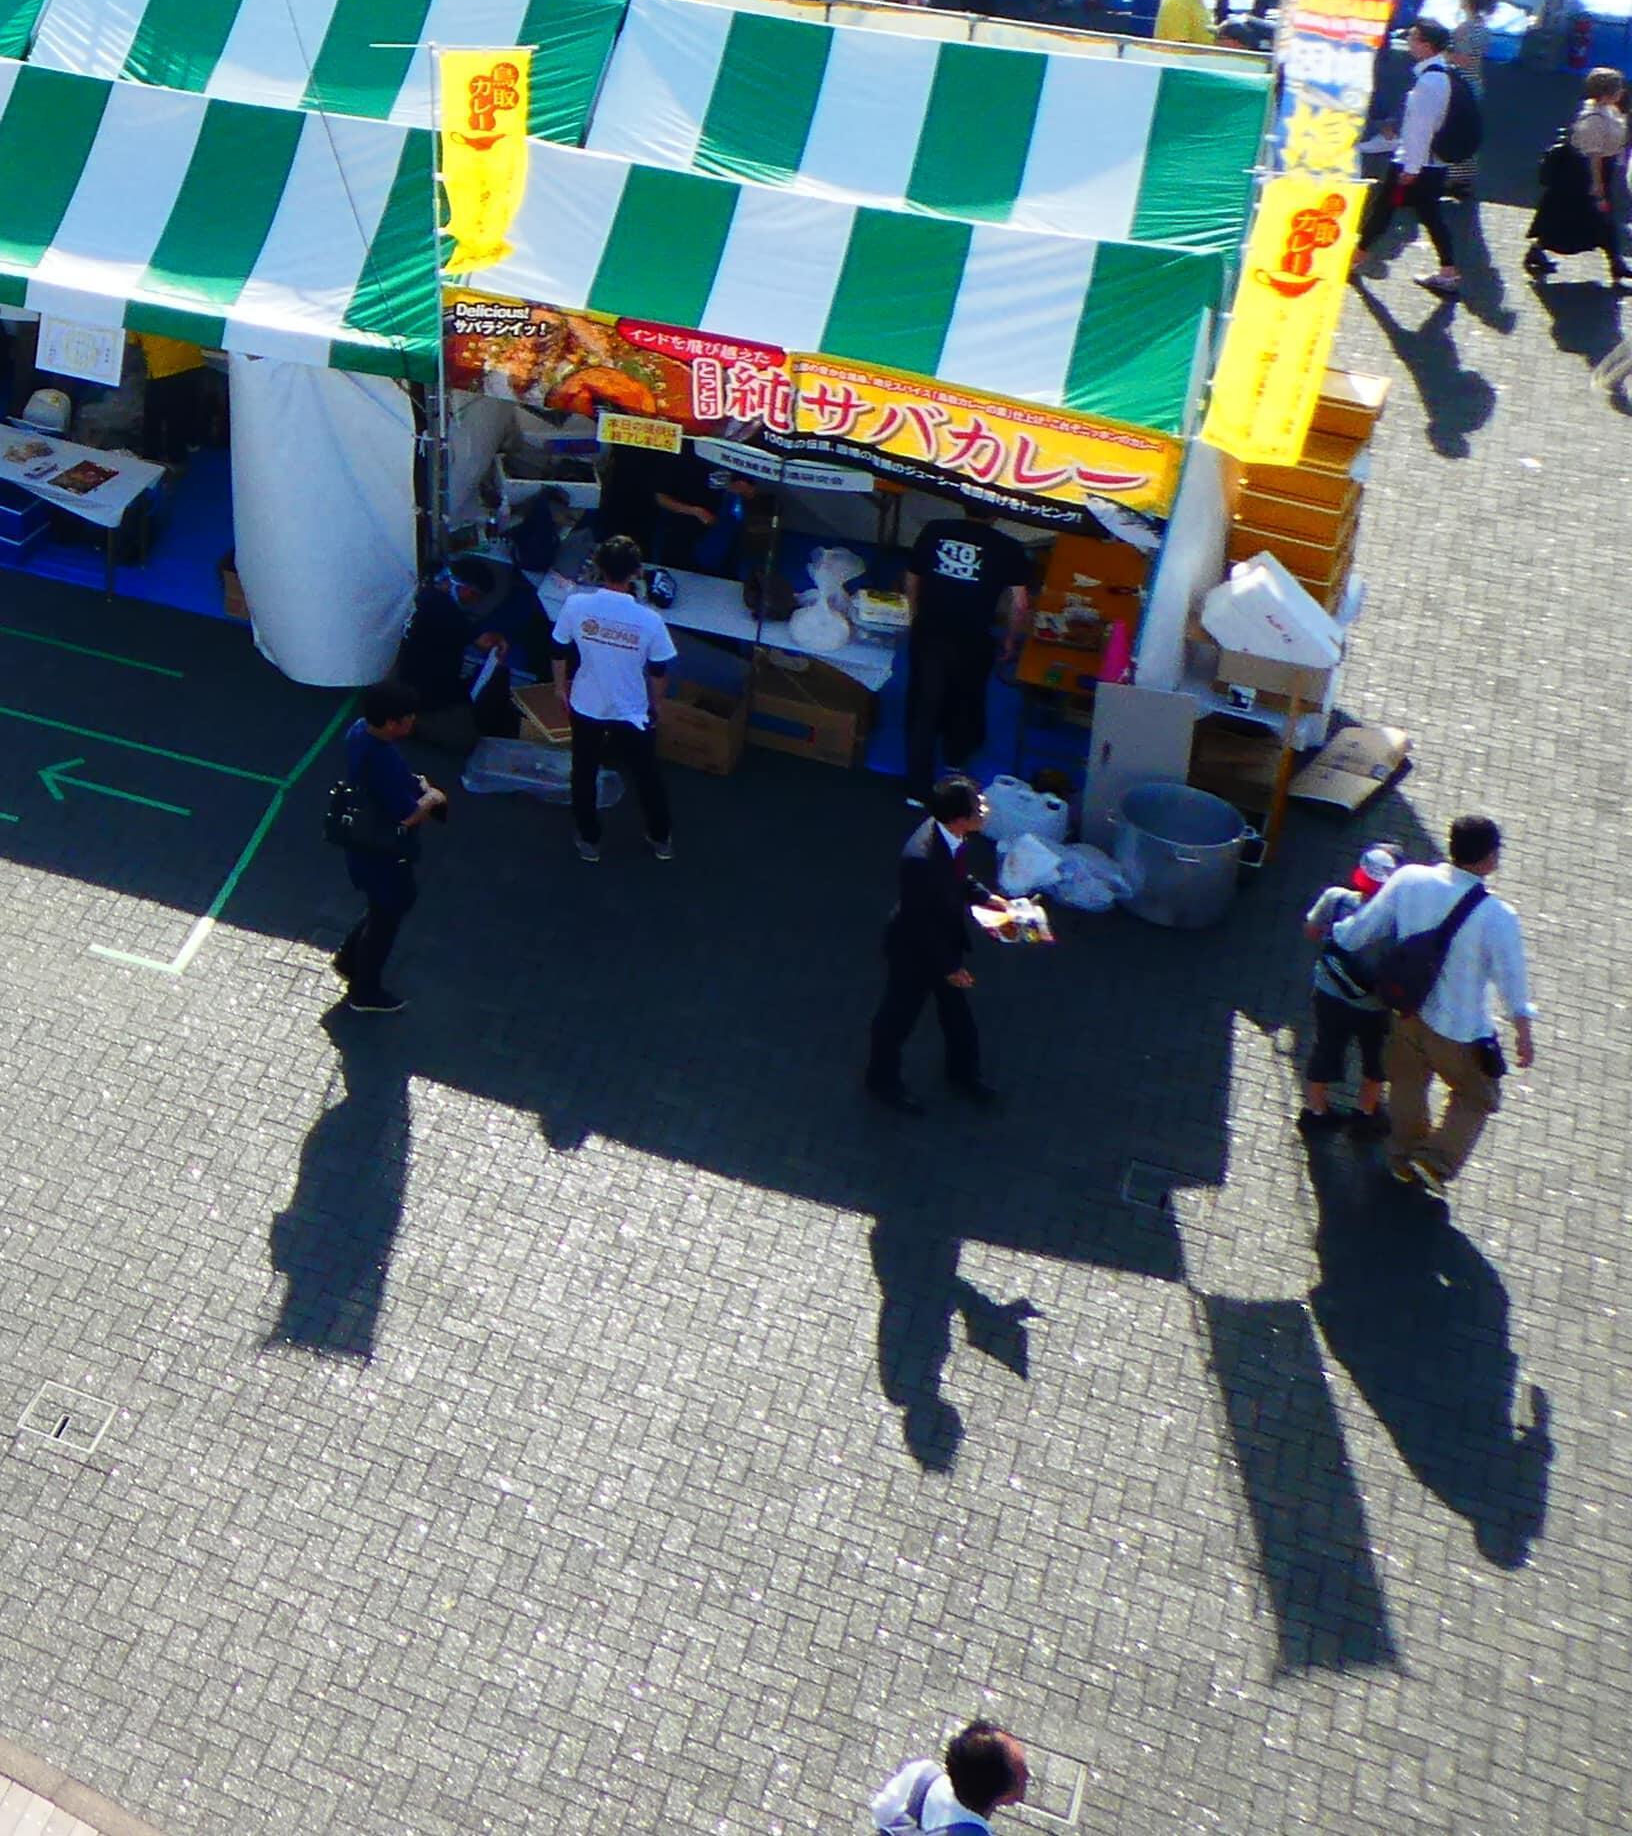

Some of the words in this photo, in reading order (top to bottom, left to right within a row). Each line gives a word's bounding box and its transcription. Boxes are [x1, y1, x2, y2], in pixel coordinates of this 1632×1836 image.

[471, 79, 492, 130] カレー
[492, 65, 516, 108] 鳥取
[455, 302, 530, 321] Delicious!
[629, 328, 771, 366] インドを飛び越えた
[696, 361, 718, 417] とっとり
[723, 359, 1150, 491] 純サバカレー
